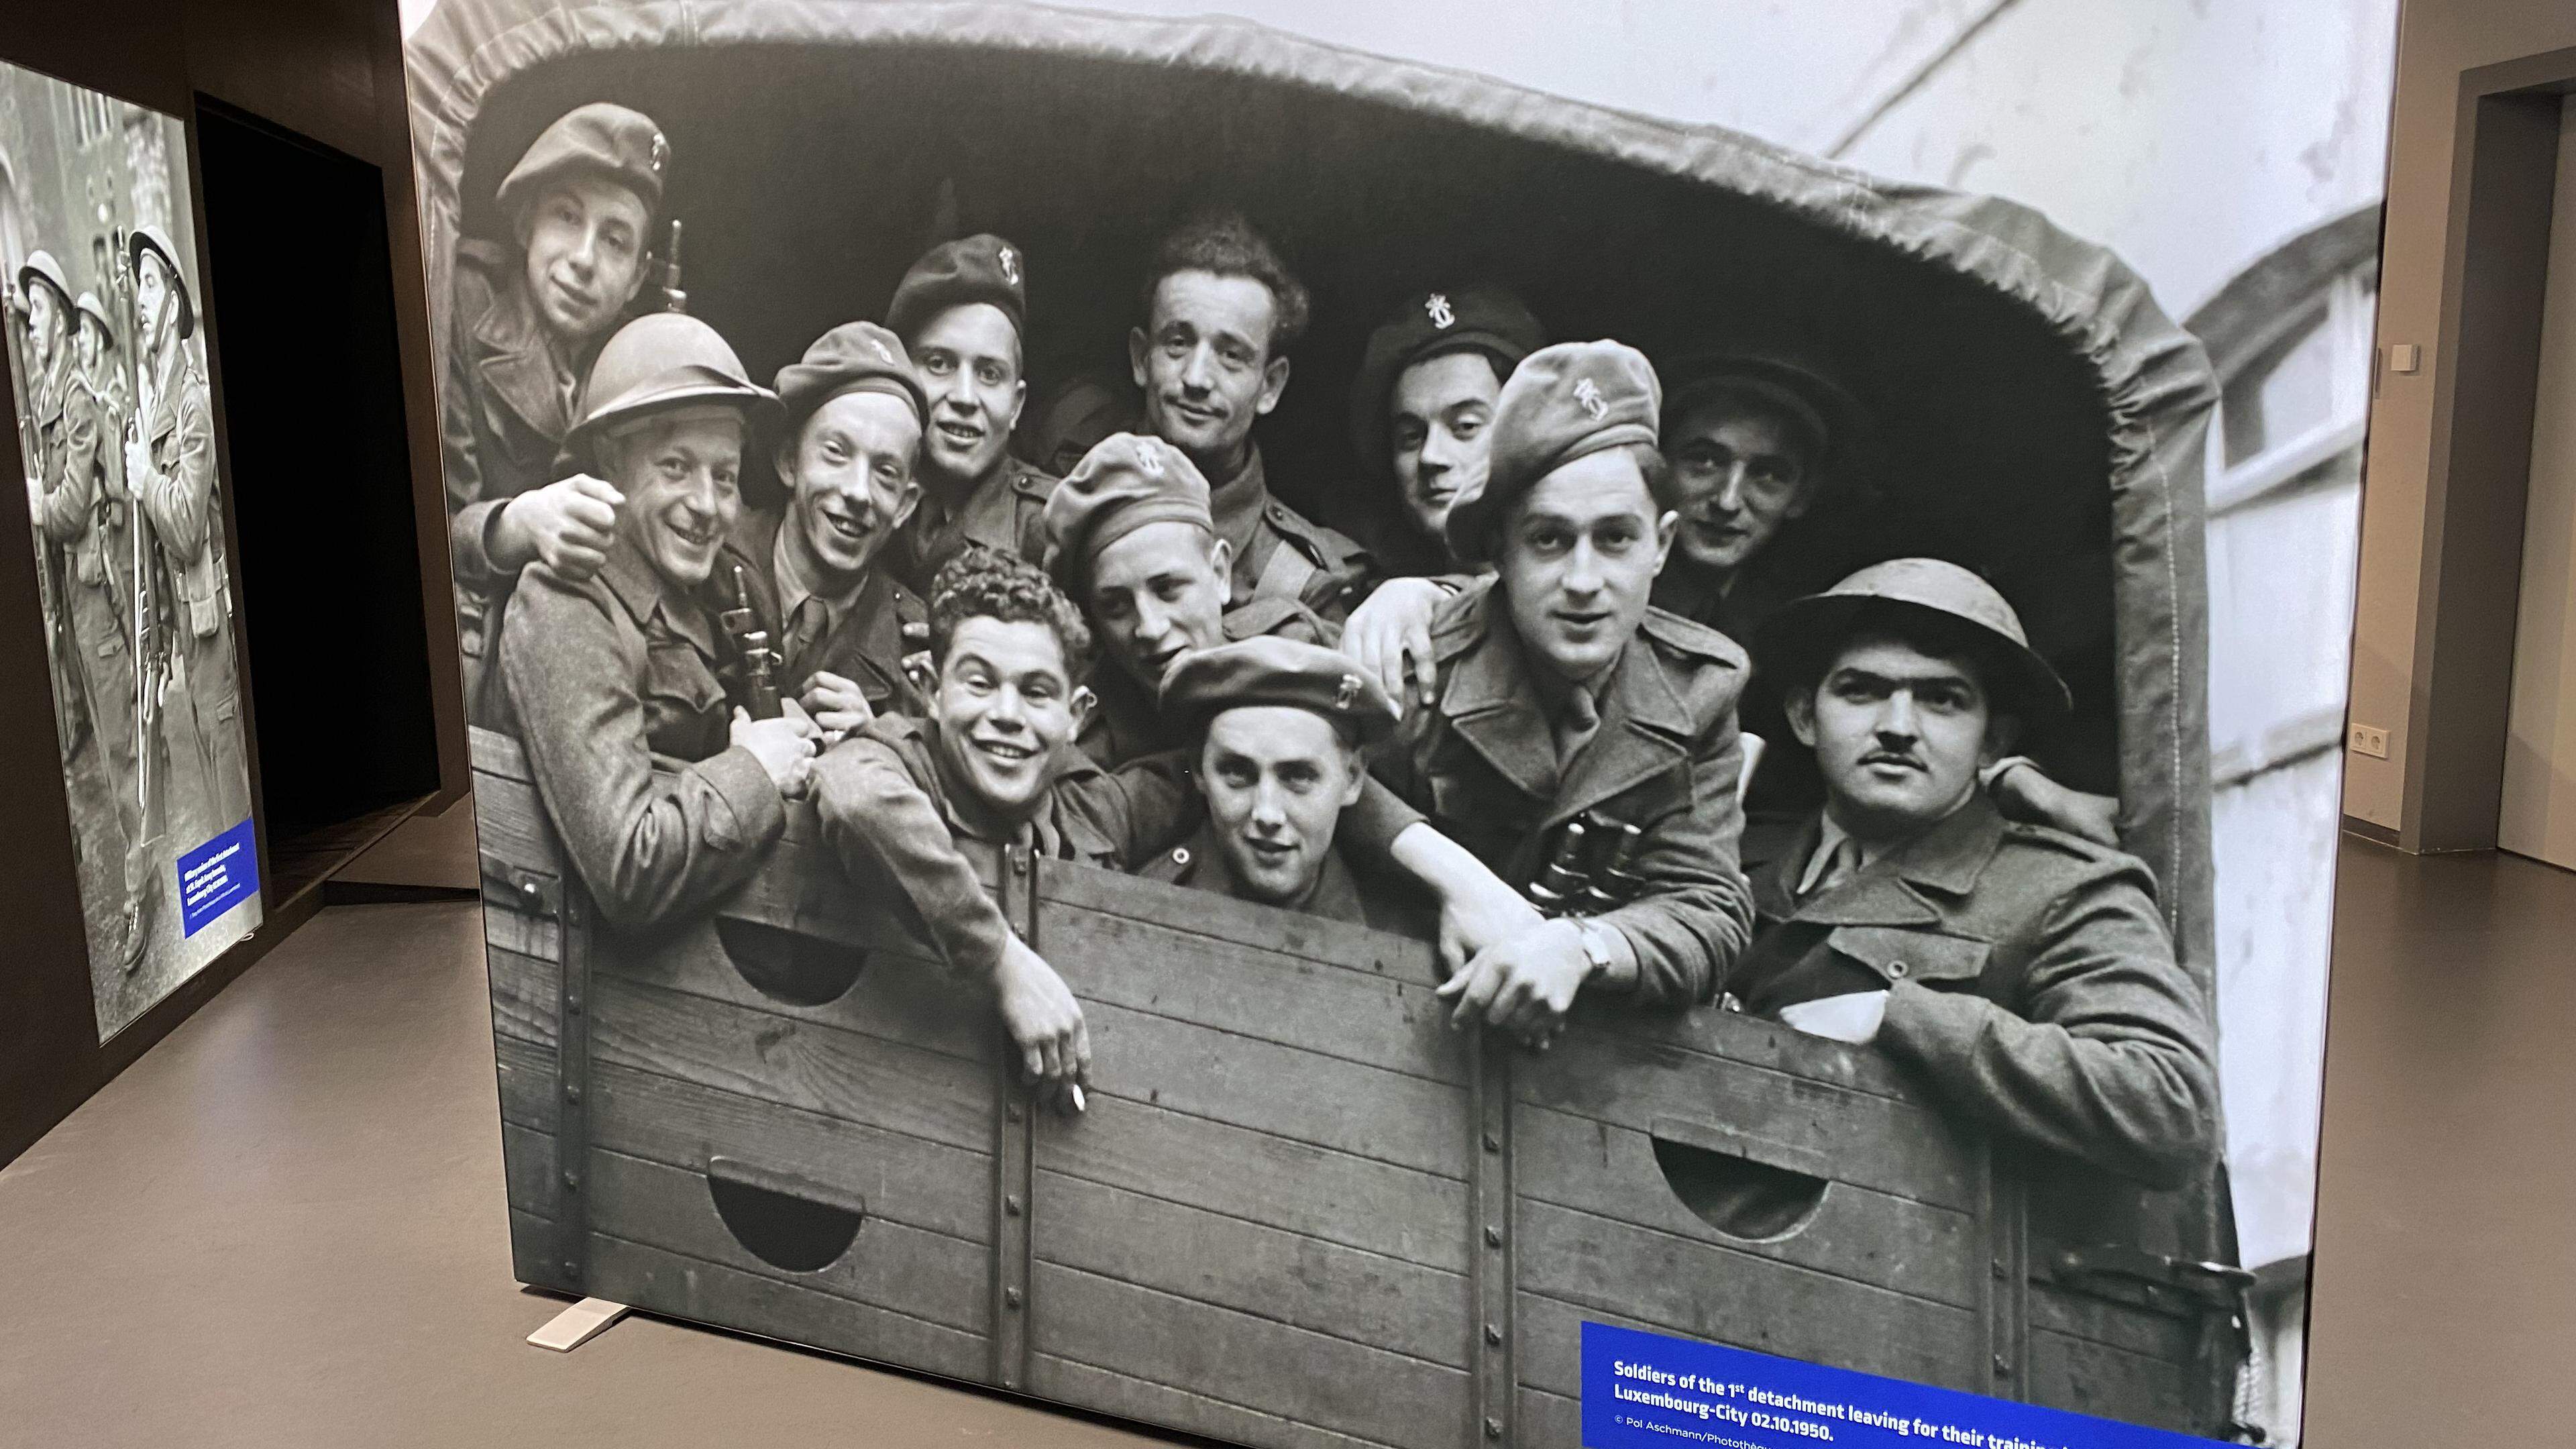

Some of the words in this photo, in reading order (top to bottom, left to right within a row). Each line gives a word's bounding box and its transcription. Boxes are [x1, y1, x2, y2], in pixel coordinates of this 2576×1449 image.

[1614, 1360, 1676, 1387] Soldiers
[1678, 1375, 1697, 1390] of
[1698, 1377, 1725, 1396] the
[1727, 1383, 1745, 1398] 1st
[1748, 1386, 1845, 1420] detachment
[1848, 1405, 1911, 1436] leaving
[1912, 1417, 1939, 1438] for
[1941, 1425, 1984, 1447] their
[1614, 1383, 1749, 1428] Luxembourg-City
[1751, 1411, 1834, 1442] 02.10.1950.
[1626, 1417, 1643, 1428] Pol
